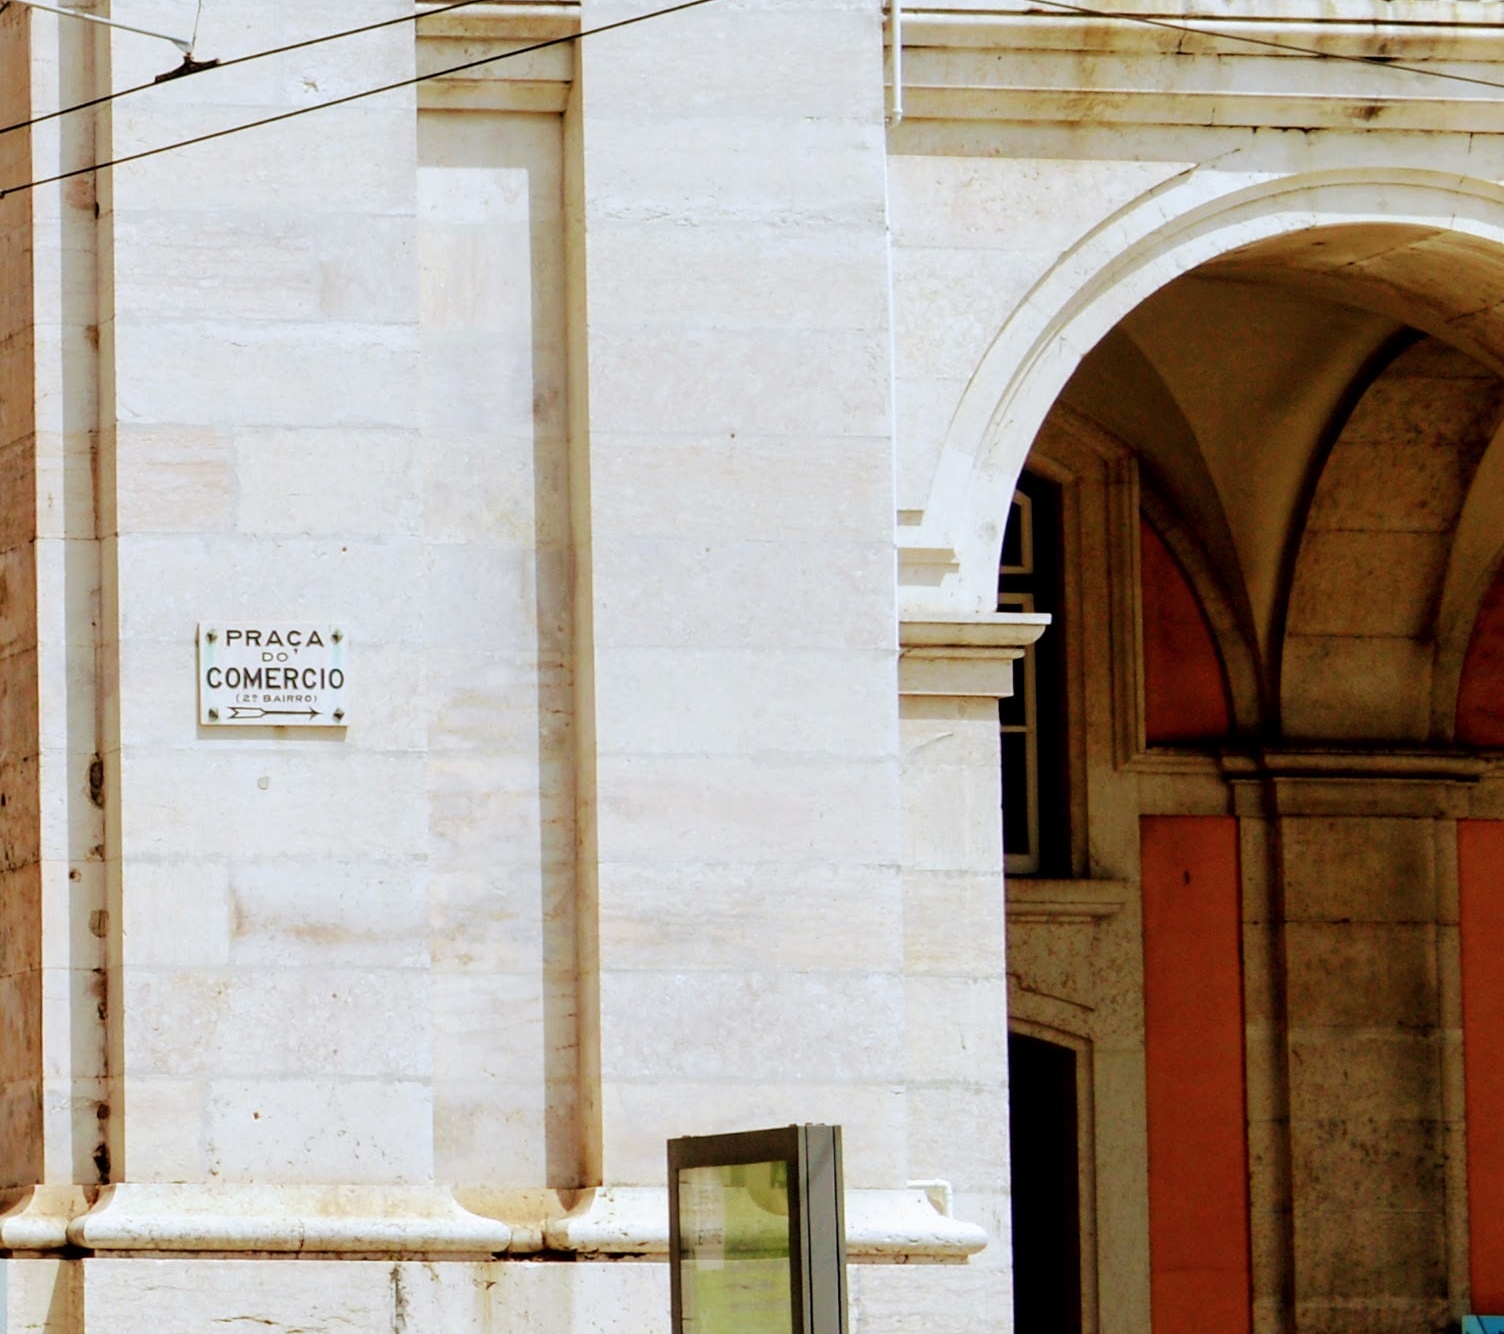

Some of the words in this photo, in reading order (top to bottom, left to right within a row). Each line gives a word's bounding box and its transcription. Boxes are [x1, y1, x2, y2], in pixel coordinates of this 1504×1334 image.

[226, 629, 325, 653] PRAÇA
[262, 652, 288, 663] DO
[206, 666, 345, 690] COMERCIO
[263, 694, 318, 704] BAIRRO)
